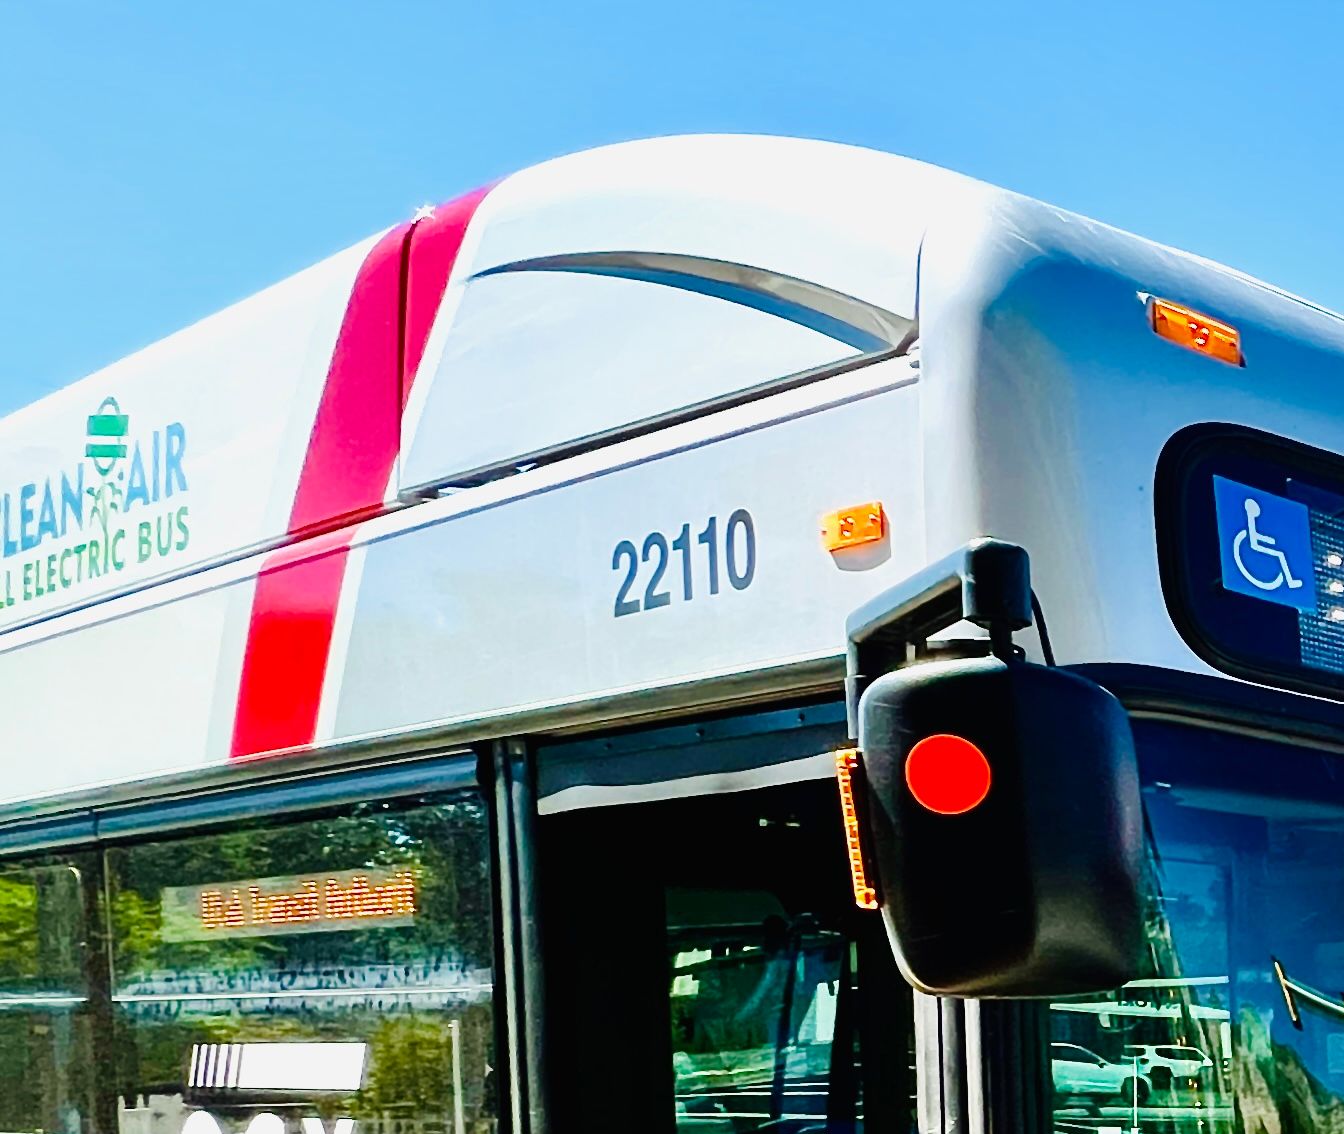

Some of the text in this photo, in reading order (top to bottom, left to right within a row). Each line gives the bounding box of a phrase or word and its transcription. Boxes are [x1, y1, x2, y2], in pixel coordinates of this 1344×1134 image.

[1, 422, 188, 558] LEAN AIR
[23, 529, 126, 601] ELECTRIC
[137, 506, 190, 563] BUS
[612, 508, 756, 617] 22110
